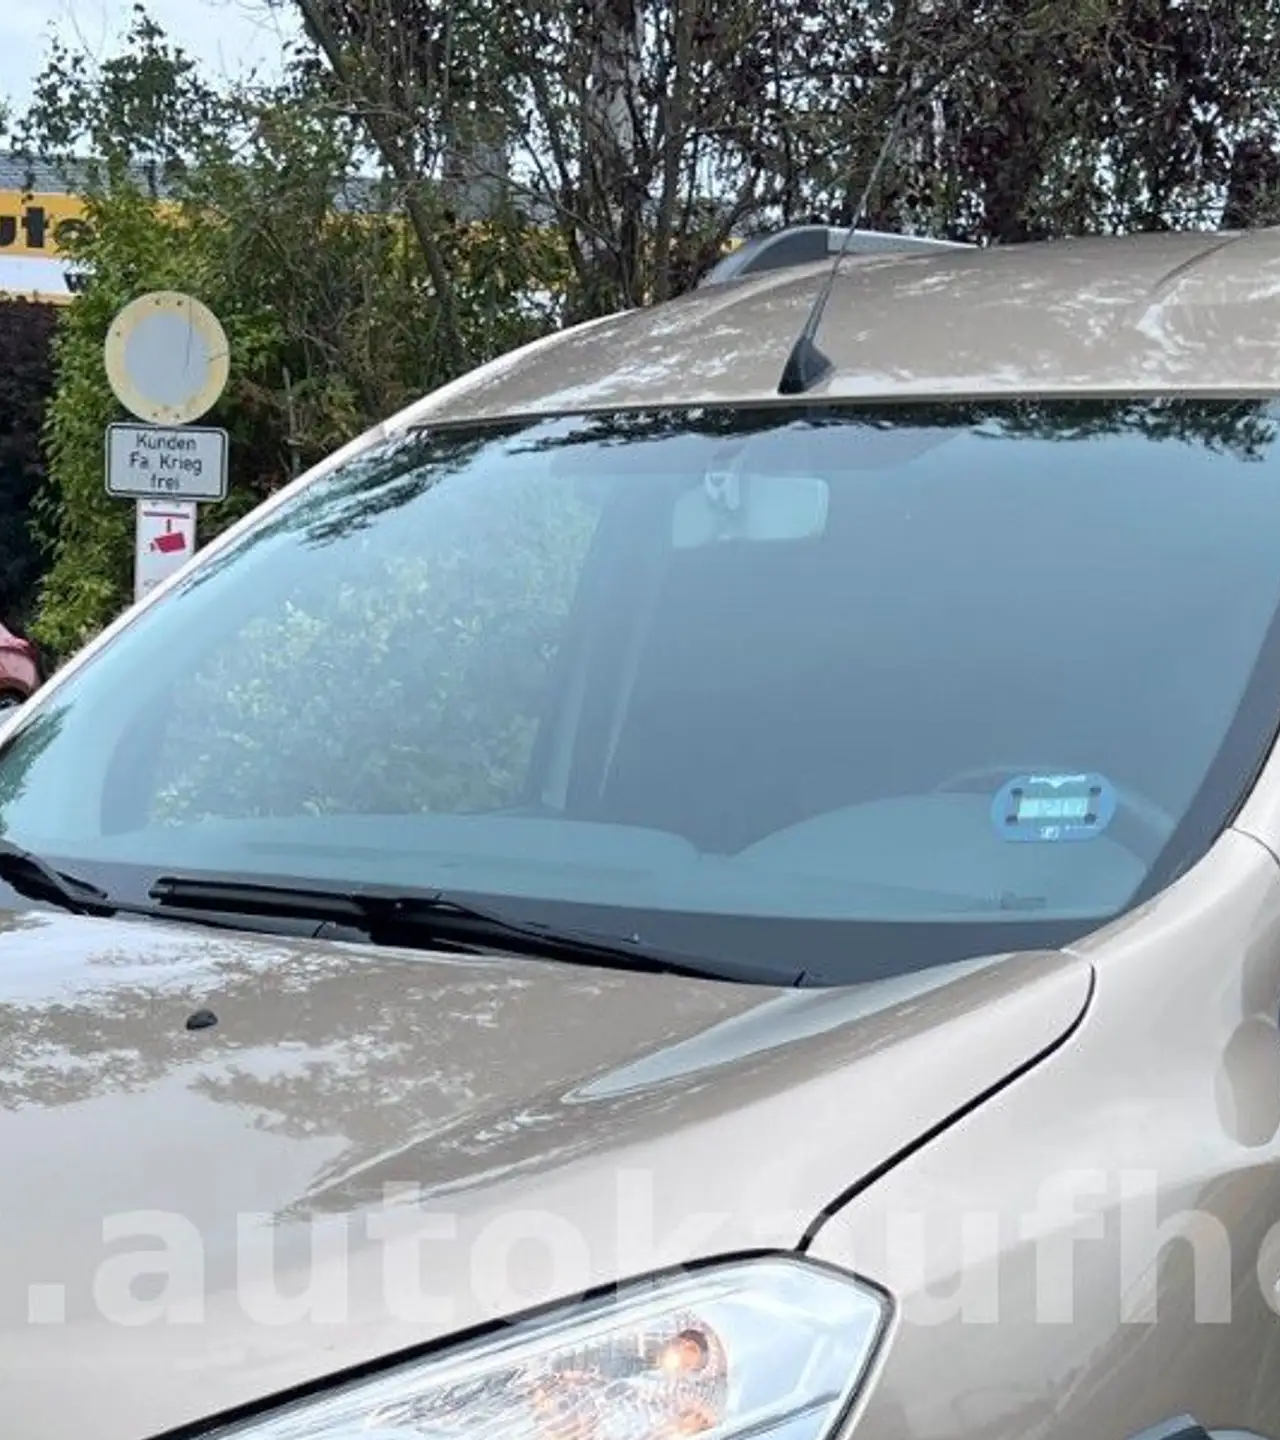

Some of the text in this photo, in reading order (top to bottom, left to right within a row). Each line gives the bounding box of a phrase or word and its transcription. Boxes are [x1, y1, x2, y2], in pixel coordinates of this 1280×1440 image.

[135, 433, 197, 450] Kunden
[158, 453, 203, 476] Krieg
[149, 473, 181, 490] frei
